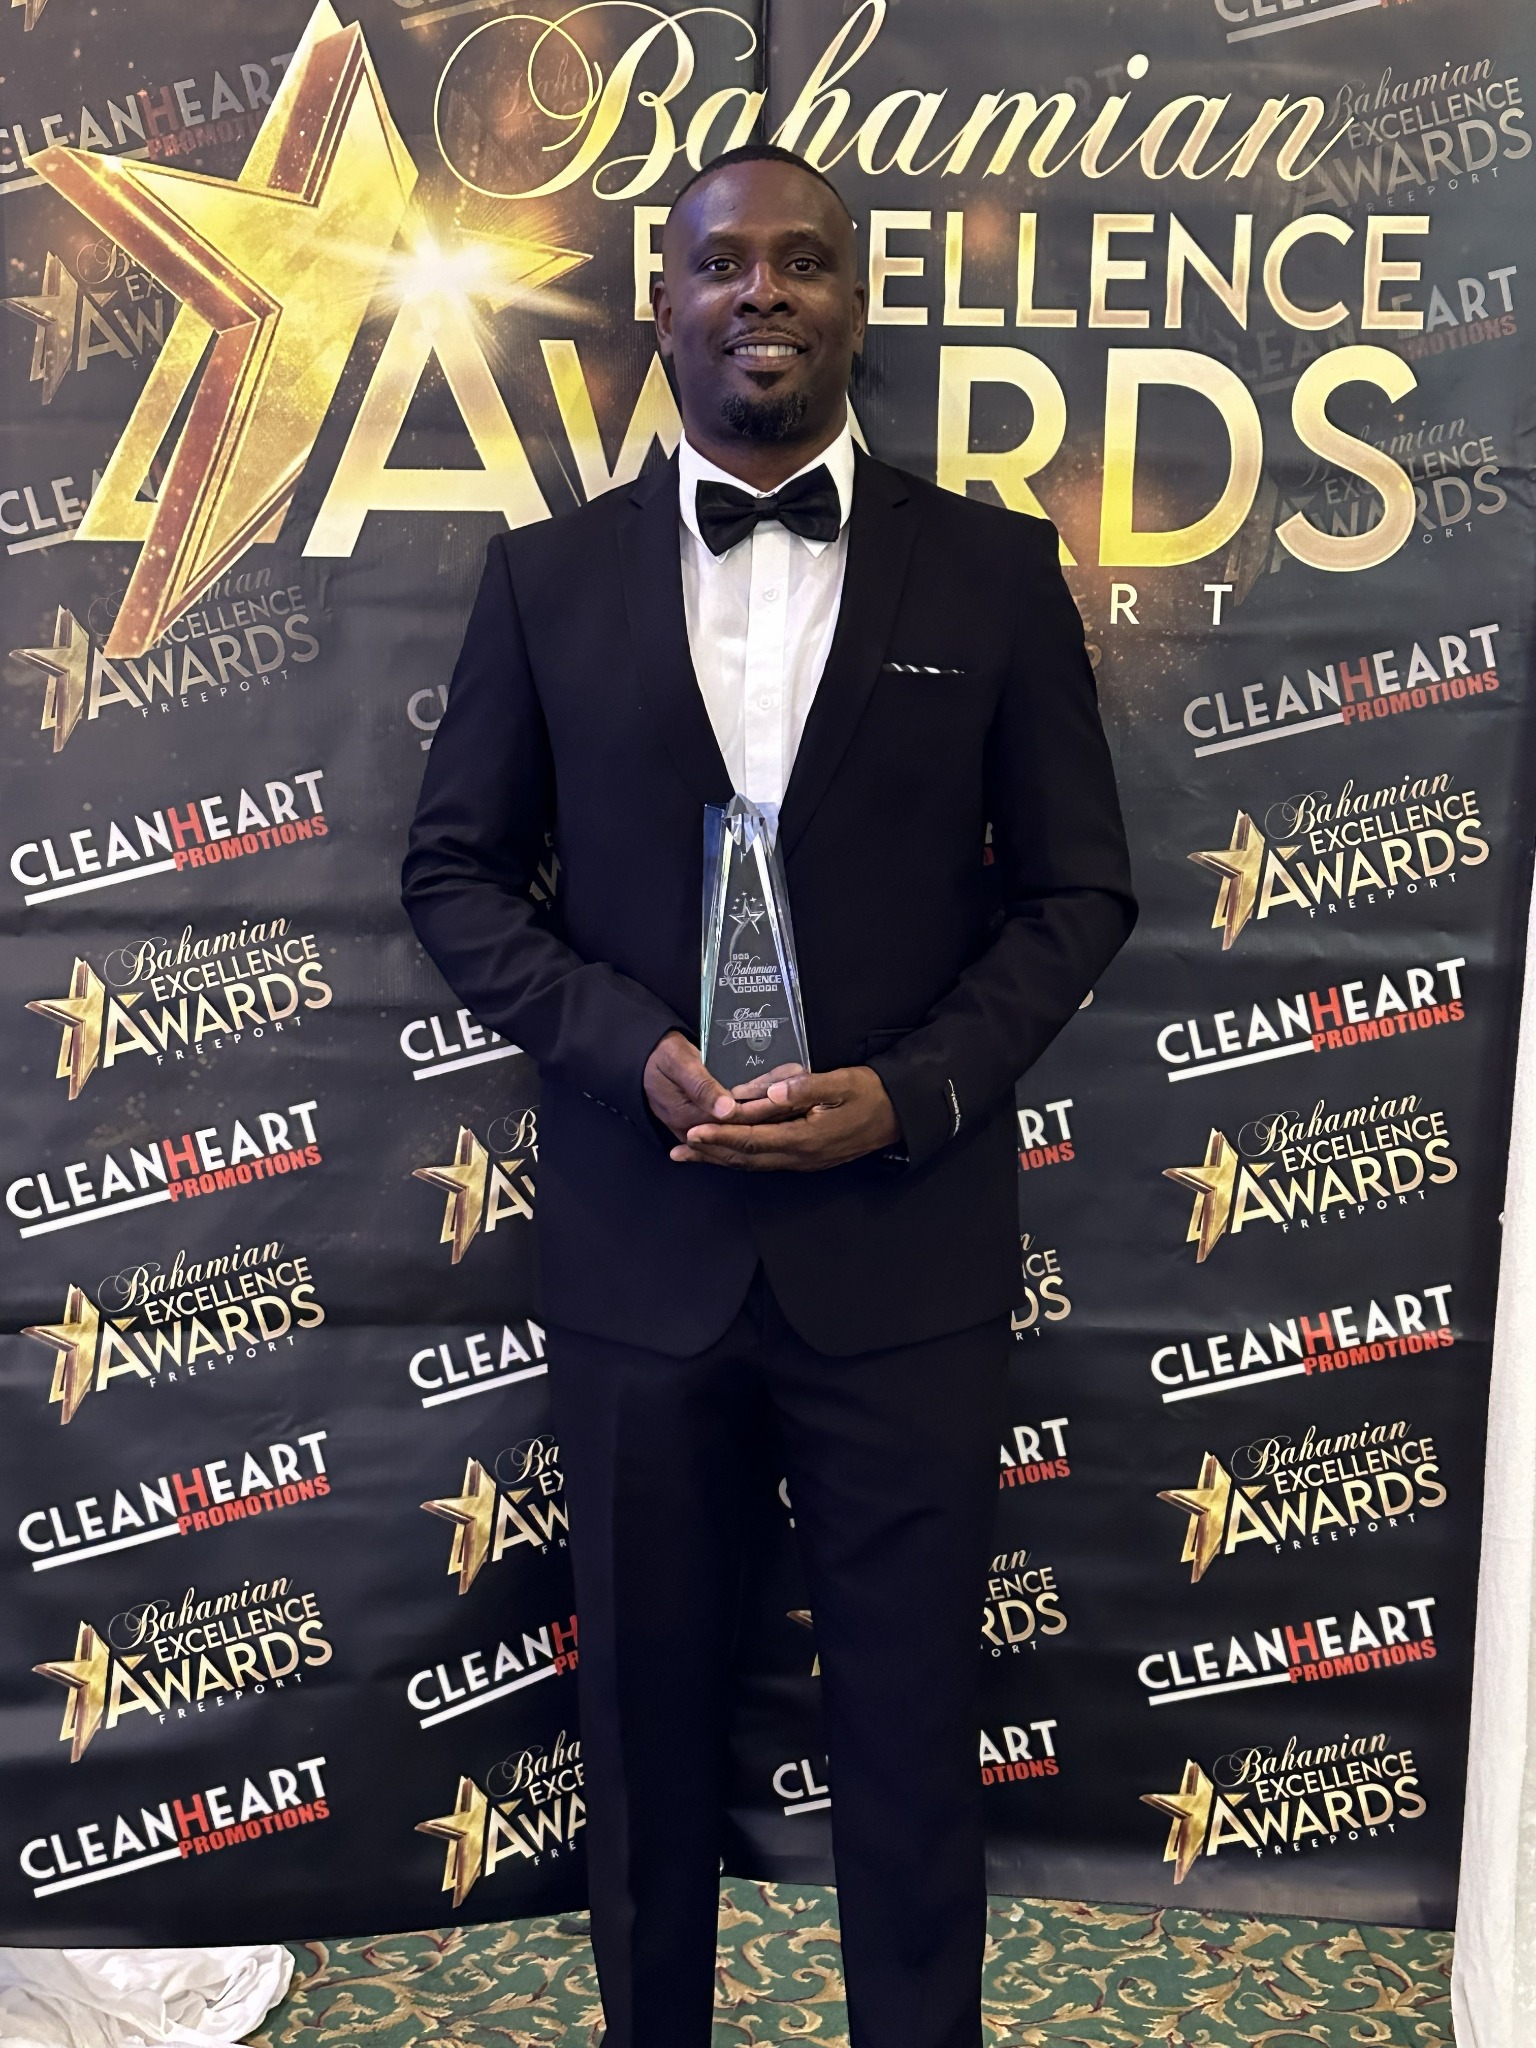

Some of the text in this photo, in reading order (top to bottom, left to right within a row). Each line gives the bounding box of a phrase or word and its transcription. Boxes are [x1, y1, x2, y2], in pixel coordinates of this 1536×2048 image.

[434, 0, 1354, 201] Bahamian
[1347, 77, 1523, 150] EXCELLENCE
[632, 205, 1430, 332] EELLENCE
[87, 614, 320, 721] AWARDS
[141, 670, 288, 718] FREEPORT
[1183, 623, 1500, 739] CLEANHEART
[1341, 670, 1500, 726] PROMOTIONS
[10, 769, 323, 886] CLEANHEART
[1264, 773, 1455, 840] Bahamian
[1309, 790, 1480, 856] EXCELLENCE
[173, 815, 329, 872] PROMOTIONS
[1256, 818, 1490, 920] AWARDS
[1309, 871, 1457, 919] FREEPORT
[104, 917, 292, 987] Bahamian
[151, 934, 320, 1002] EXCELLENCE
[719, 974, 782, 988] EXCELLENCE
[103, 961, 333, 1069] AWARDS
[156, 1015, 302, 1066] FREEPORT
[727, 1019, 779, 1031] TELEPHONE
[732, 1028, 773, 1040] COMPANY
[1156, 957, 1466, 1064] CLEANHEART
[1311, 1001, 1465, 1053] PROMOTIONS
[1237, 1093, 1423, 1157] Bahamian
[1281, 1111, 1449, 1173] EXCELLENCE
[5, 1100, 318, 1220] CLEANHEART
[168, 1145, 322, 1203] PROMOTIONS
[1230, 1138, 1458, 1234] AWARDS
[1282, 1190, 1426, 1233] FREEPORT
[98, 1241, 285, 1313] Bahamian
[144, 1257, 313, 1325] EXCELLENCE
[95, 1283, 326, 1392] AWARDS
[149, 1335, 295, 1388] FREEPORT
[1150, 1283, 1453, 1385] CLEANHEART
[1302, 1327, 1455, 1376] PROMOTIONS
[1230, 1420, 1412, 1481] Bahamian
[1273, 1437, 1437, 1495] EXCELLENCE
[18, 1430, 327, 1553] CLEANHEART
[177, 1475, 331, 1536] PROMOTIONS
[1224, 1462, 1447, 1555] AWARDS
[1274, 1512, 1416, 1555] FREEPORT
[108, 1577, 294, 1650] Bahamian
[154, 1592, 321, 1664] EXCELLENCE
[1137, 1597, 1436, 1690] CLEANHEART
[105, 1619, 333, 1730] AWARDS
[1288, 1638, 1438, 1684] PROMOTIONS
[159, 1673, 303, 1725] FREEPORT
[1212, 1732, 1392, 1788] Bahamian
[1255, 1750, 1417, 1804] EXCELLENCE
[19, 1756, 327, 1879] CLEANHEART
[178, 1799, 330, 1859] PROMOTIONS
[1206, 1775, 1427, 1857] AWARDS
[1256, 1823, 1396, 1858] FREEPORT
